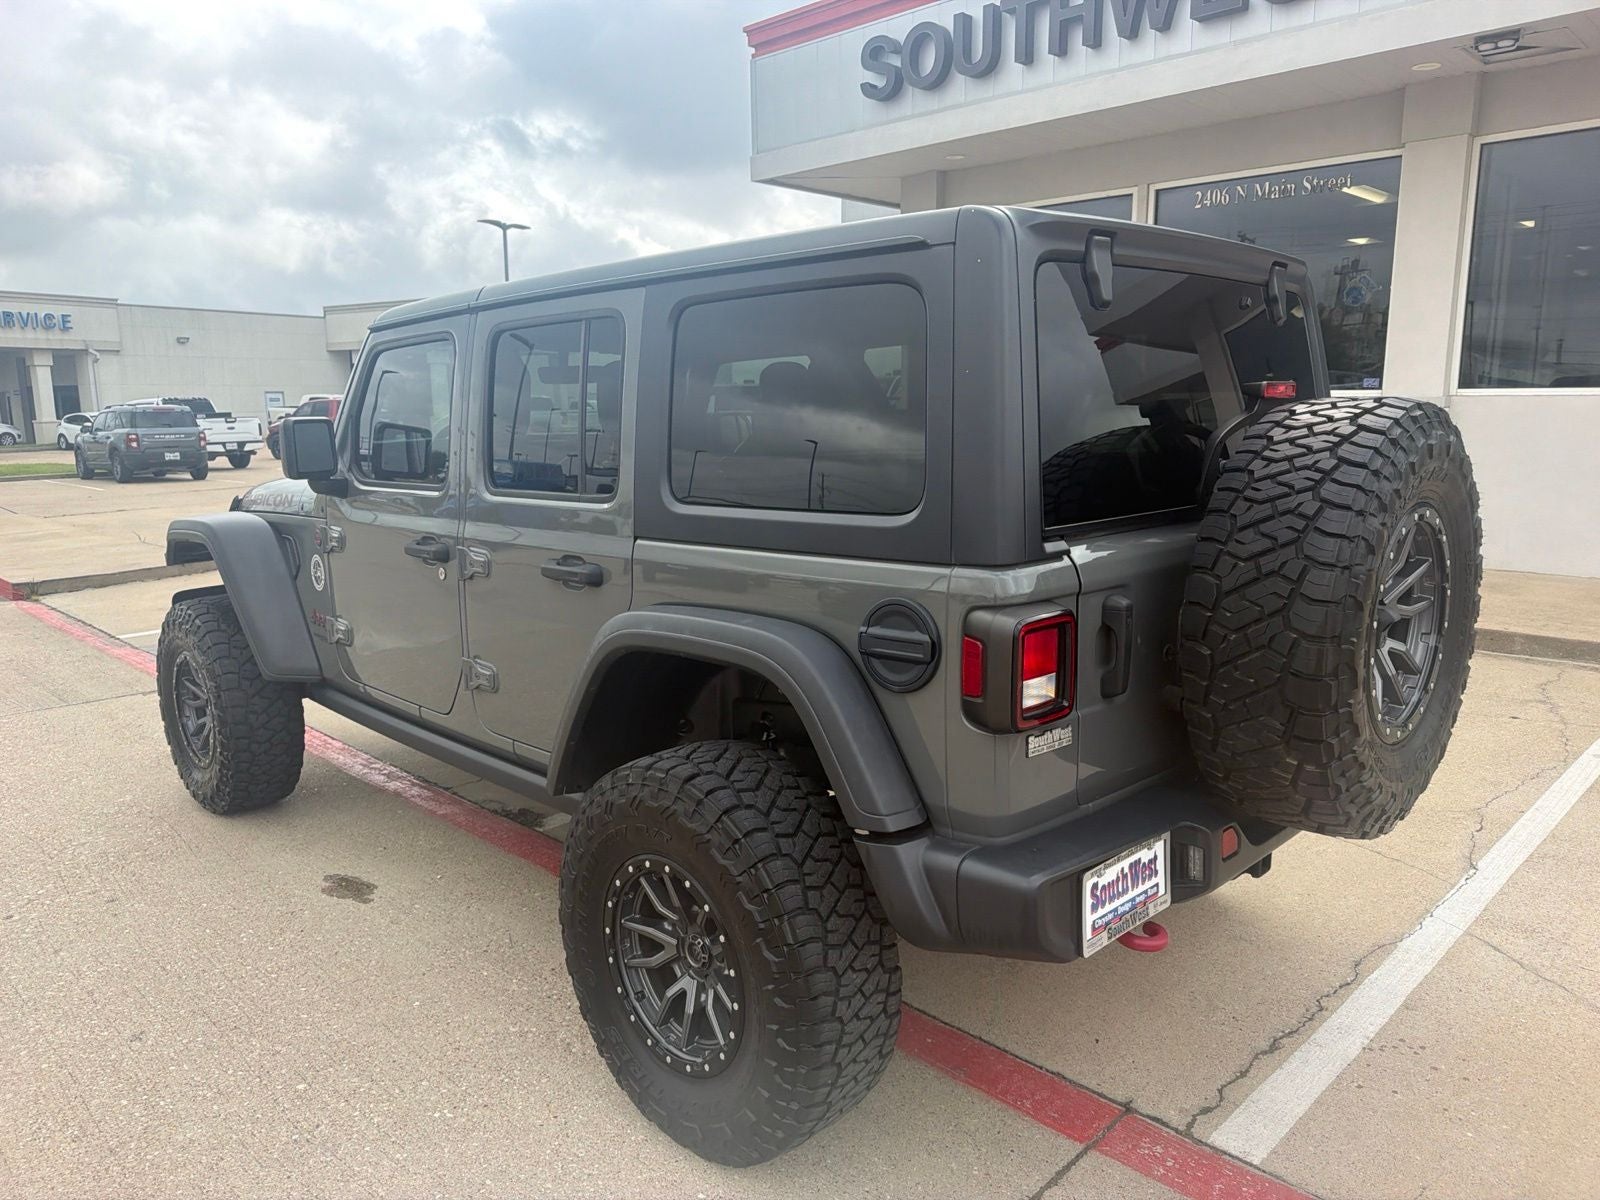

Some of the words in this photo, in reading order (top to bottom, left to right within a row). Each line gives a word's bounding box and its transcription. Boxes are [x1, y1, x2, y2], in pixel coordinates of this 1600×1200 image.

[1195, 187, 1230, 208] 2406
[1235, 185, 1248, 203] N
[1253, 178, 1296, 201] Main
[1302, 173, 1353, 196] Street
[0, 311, 74, 332] RVICE
[1090, 850, 1158, 915] SouthWest
